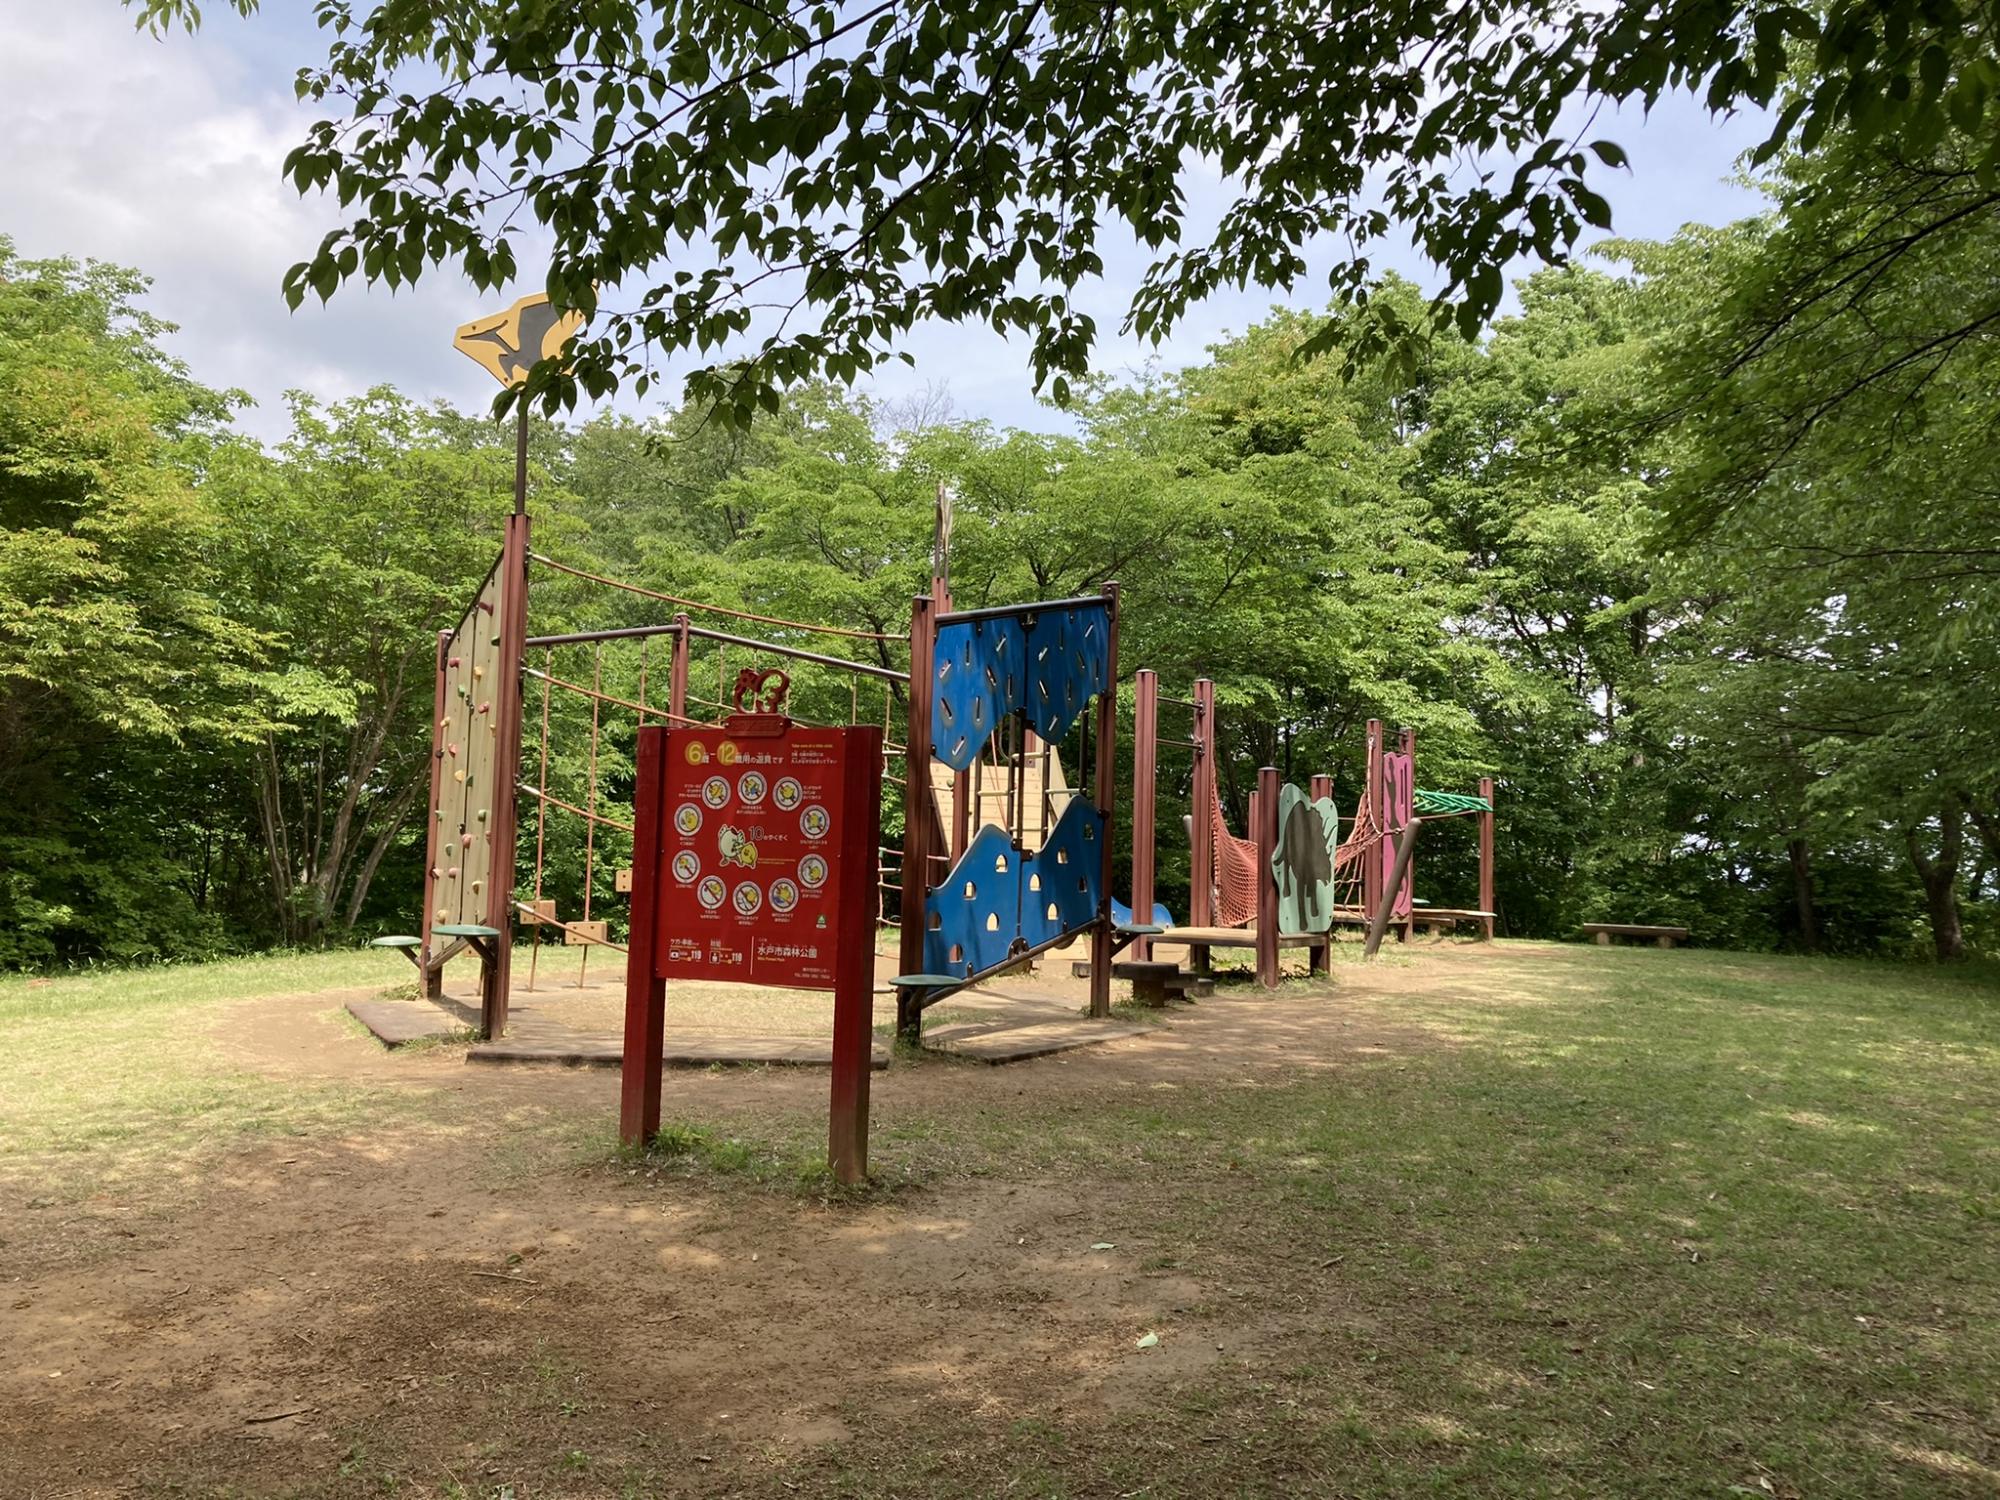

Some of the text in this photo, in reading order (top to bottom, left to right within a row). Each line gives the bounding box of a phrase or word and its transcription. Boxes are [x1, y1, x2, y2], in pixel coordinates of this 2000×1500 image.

[757, 944, 817, 959] 水戸市森林公園
